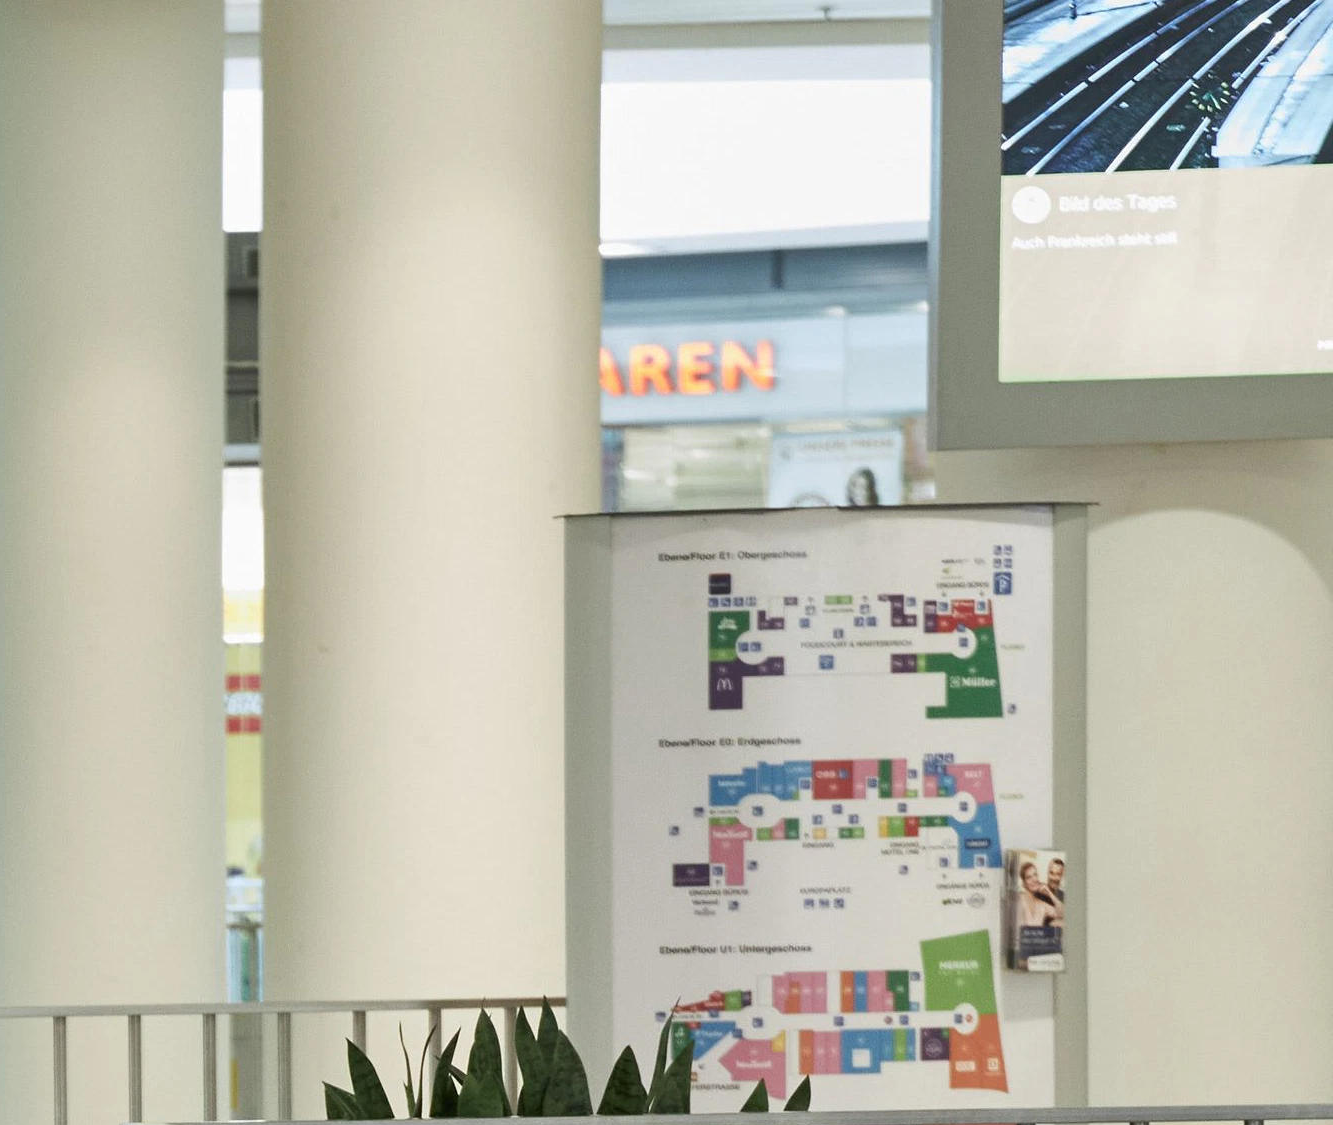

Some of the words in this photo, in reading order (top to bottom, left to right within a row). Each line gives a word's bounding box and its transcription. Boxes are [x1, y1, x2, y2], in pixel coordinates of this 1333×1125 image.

[1059, 195, 1089, 212] Bild
[1093, 195, 1123, 211] des
[1126, 193, 1177, 212] Tages
[962, 677, 997, 687] Müller
